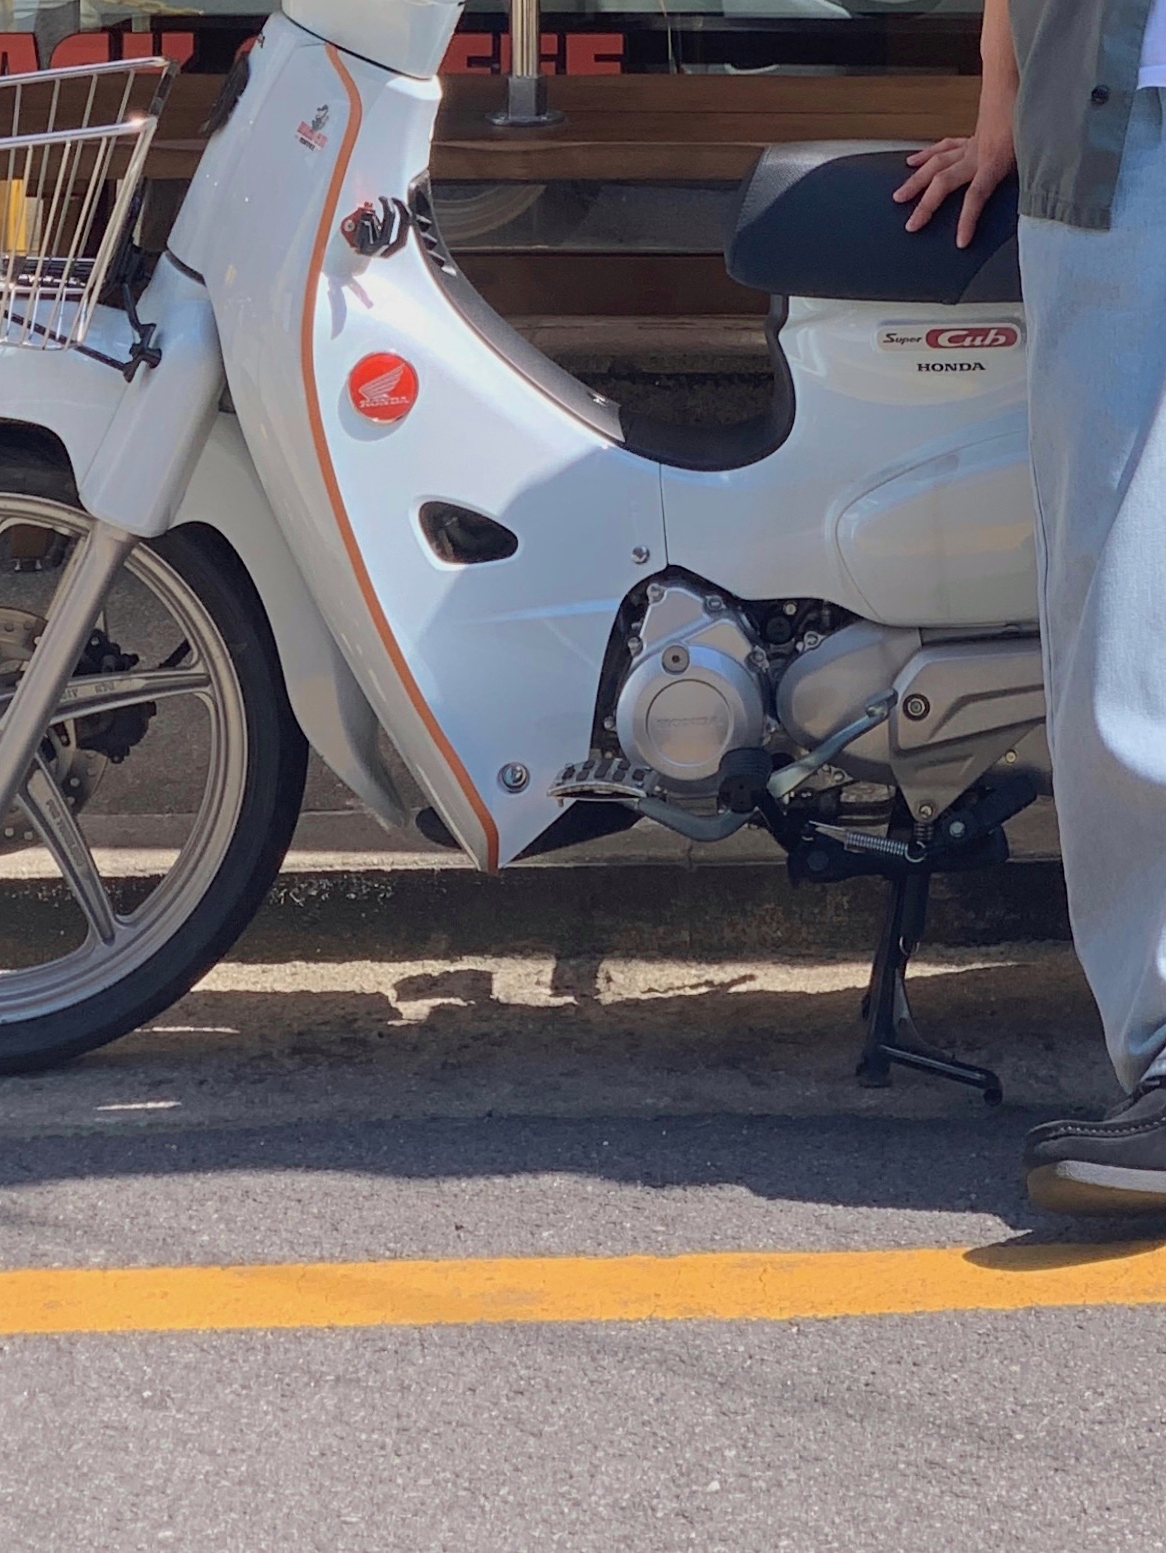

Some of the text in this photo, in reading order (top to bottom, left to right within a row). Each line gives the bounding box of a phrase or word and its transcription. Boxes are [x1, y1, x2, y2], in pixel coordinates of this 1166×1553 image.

[883, 328, 1006, 348] Super Cub
[917, 362, 986, 372] HONDA
[359, 396, 410, 408] HONDA
